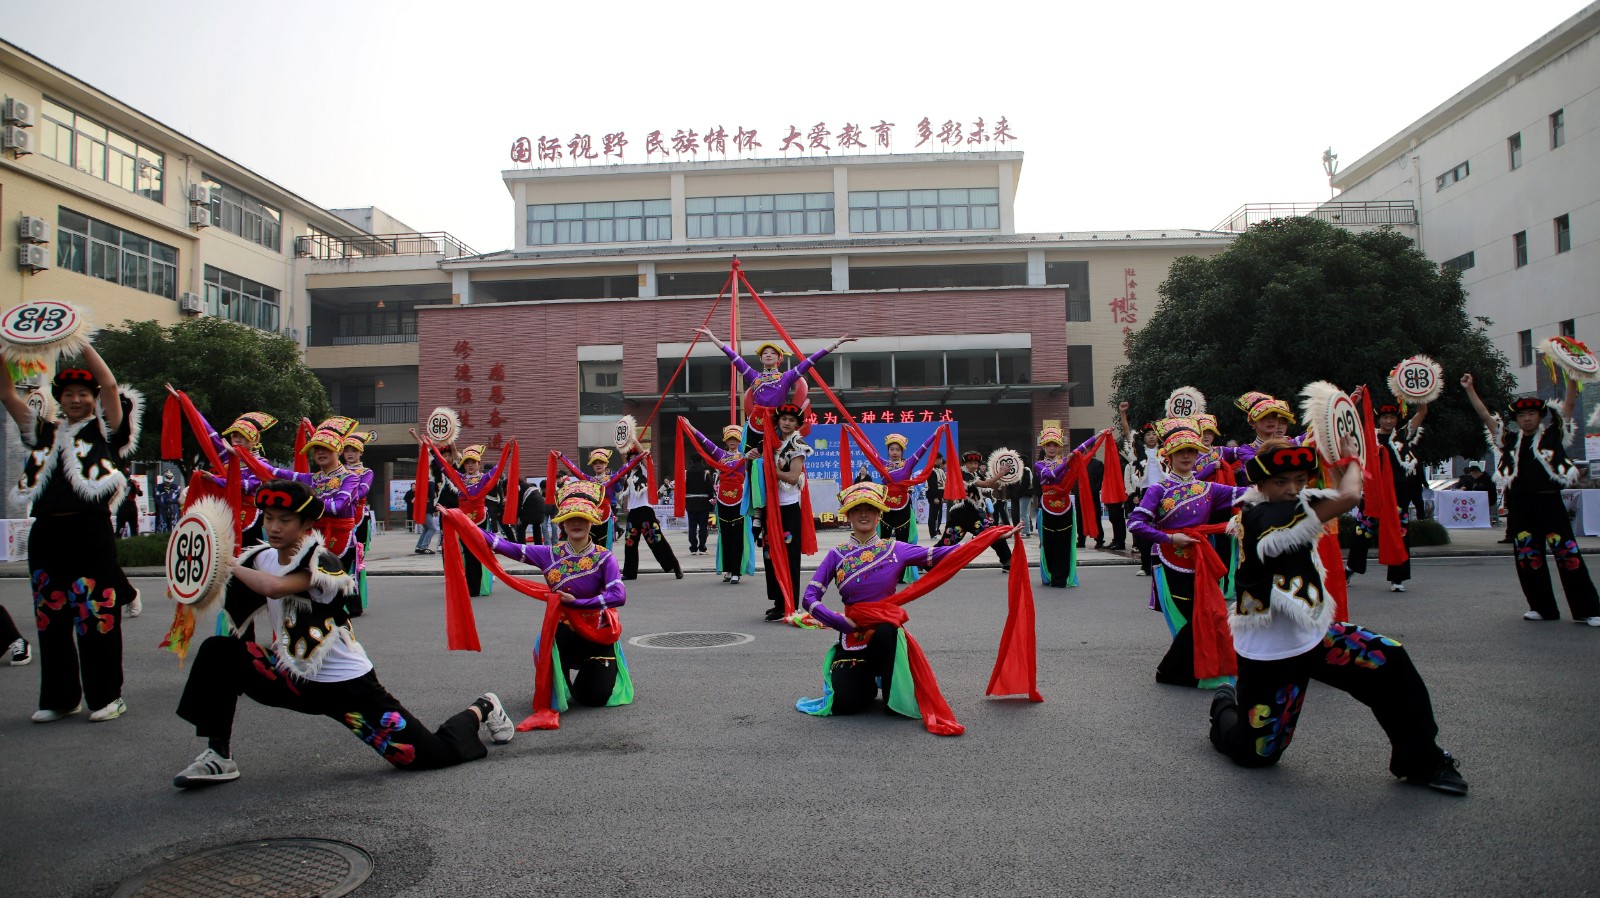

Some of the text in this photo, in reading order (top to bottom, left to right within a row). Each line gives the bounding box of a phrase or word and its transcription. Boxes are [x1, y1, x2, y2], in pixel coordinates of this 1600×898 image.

[510, 115, 1018, 163] 国际视野 民族情怀 大爱教育 多彩未来
[1108, 296, 1138, 324] 核心
[1126, 268, 1138, 311] 社会主义
[453, 339, 474, 428] 修德强技
[487, 361, 508, 450] 感恩奋进
